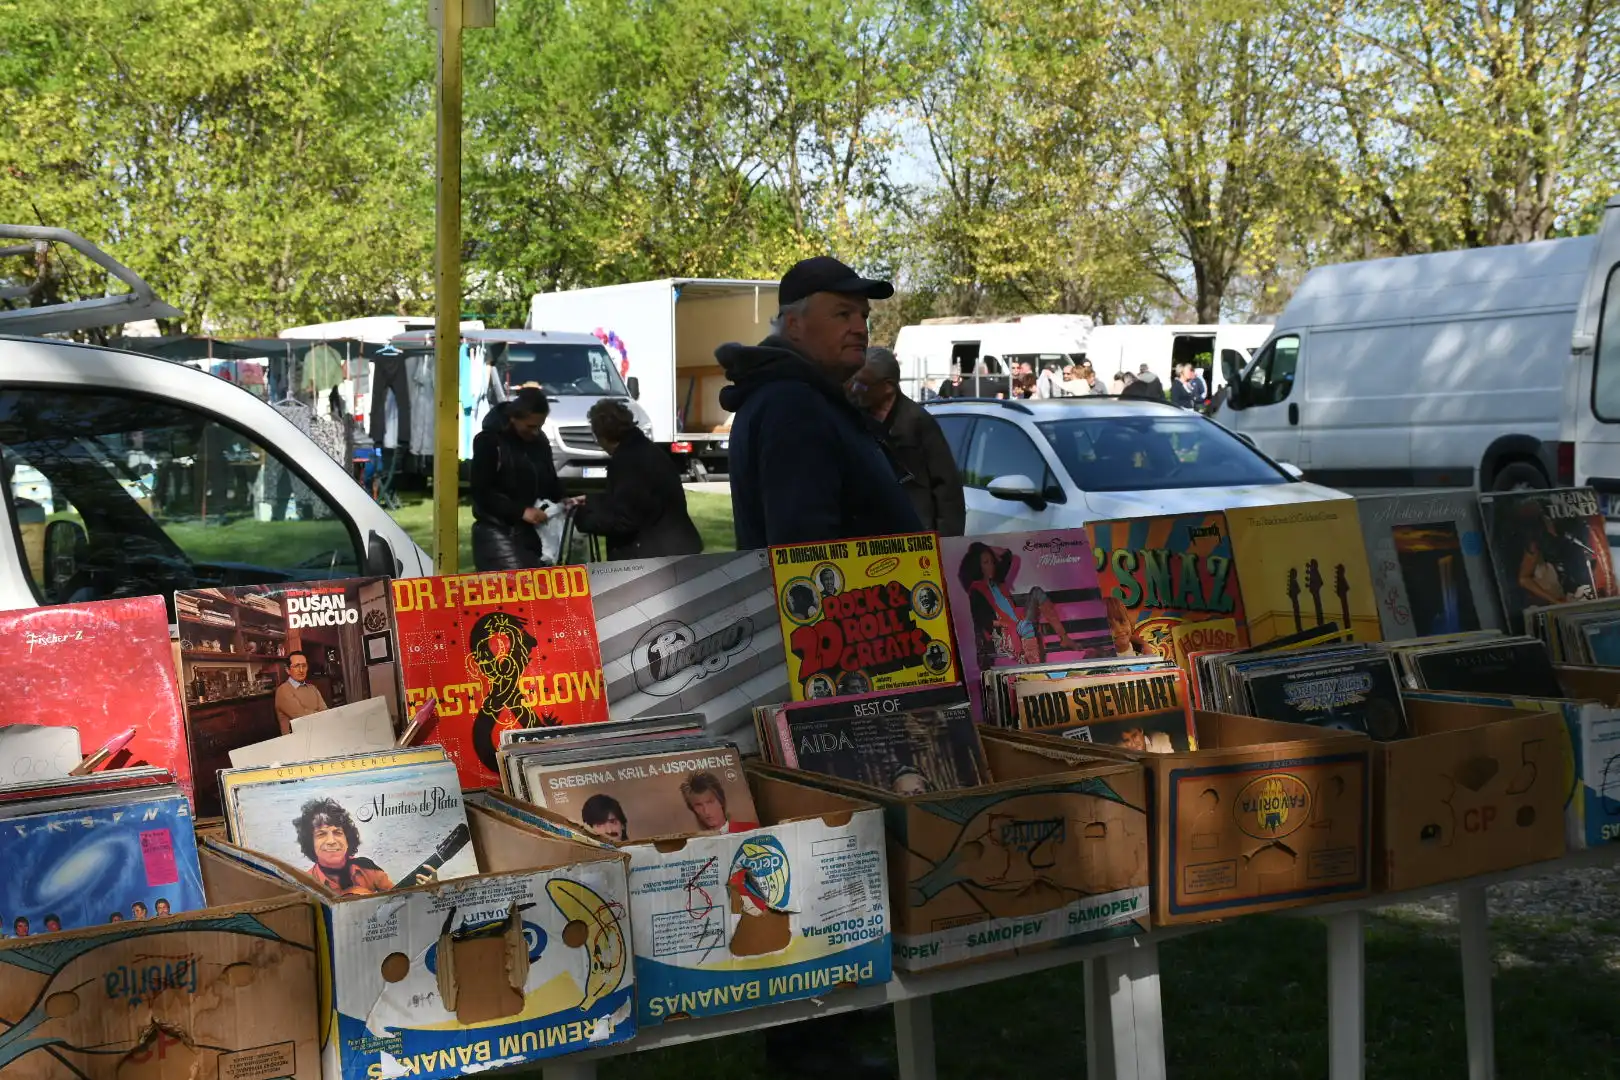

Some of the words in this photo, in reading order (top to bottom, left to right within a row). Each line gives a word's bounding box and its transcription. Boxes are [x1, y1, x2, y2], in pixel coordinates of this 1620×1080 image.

[1545, 501, 1598, 519] TURNER
[776, 549, 788, 565] 20
[789, 545, 828, 562] ORIGINAL
[828, 543, 849, 558] HITS
[856, 541, 869, 557] 20
[869, 537, 907, 556] ORIGINAL
[907, 535, 934, 552] STARS
[287, 594, 346, 613] DUŠAN
[392, 579, 438, 612] DR
[442, 567, 589, 608] FEELGOOD
[821, 585, 887, 621] ROCK
[887, 580, 910, 608] &
[289, 608, 358, 629] DANČUO
[841, 609, 904, 644] ROLL
[790, 619, 844, 680] 20
[839, 627, 928, 672] GREATS
[1179, 627, 1236, 653] HOUSE
[407, 682, 482, 720] FAST
[519, 669, 601, 708] SLOW
[853, 702, 881, 717] BEST
[883, 699, 901, 713] OF
[1022, 690, 1071, 729] ROD
[1072, 674, 1178, 722] STEWART
[800, 730, 854, 755] AIDA
[276, 756, 398, 777] QUINTESSENCE
[548, 771, 615, 790] SREBRNA
[1505, 738, 1546, 796] 5
[356, 792, 417, 823] Manitas
[419, 789, 432, 812] de
[424, 786, 460, 817] Plata
[1242, 794, 1305, 813] FAVORITA
[1464, 806, 1497, 833] CP
[867, 913, 884, 925] OF
[1068, 896, 1139, 925] SAMOPEV
[827, 926, 884, 946] PRODUCE
[967, 919, 1043, 948] SAMOPEV
[106, 959, 197, 999] favorita
[768, 960, 873, 996] PREMIUM
[648, 980, 760, 1016] BANANAS
